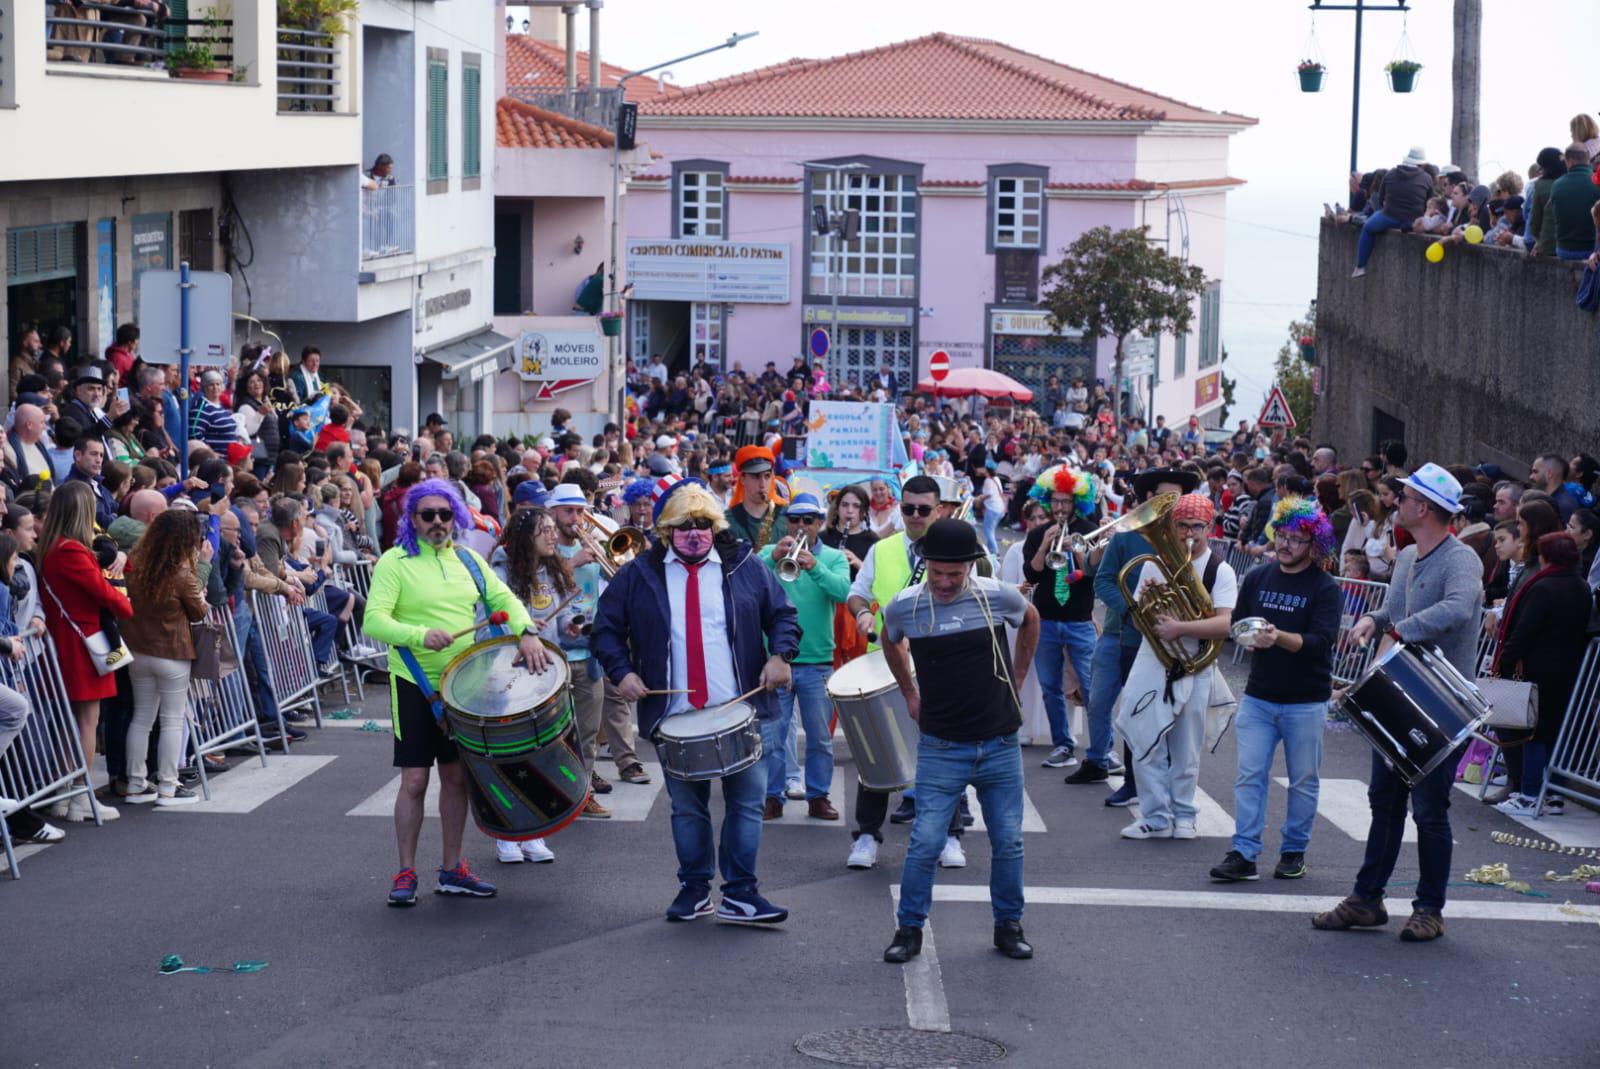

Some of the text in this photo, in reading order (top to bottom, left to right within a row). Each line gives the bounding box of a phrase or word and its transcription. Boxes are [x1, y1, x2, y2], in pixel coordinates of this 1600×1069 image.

[630, 245, 673, 257] CENTRO
[675, 244, 738, 259] COMERCIAL
[740, 246, 749, 259] O
[554, 342, 595, 353] MÓVEIS
[550, 356, 599, 366] MOLEIRO
[1258, 590, 1307, 608] TIFFOSI
